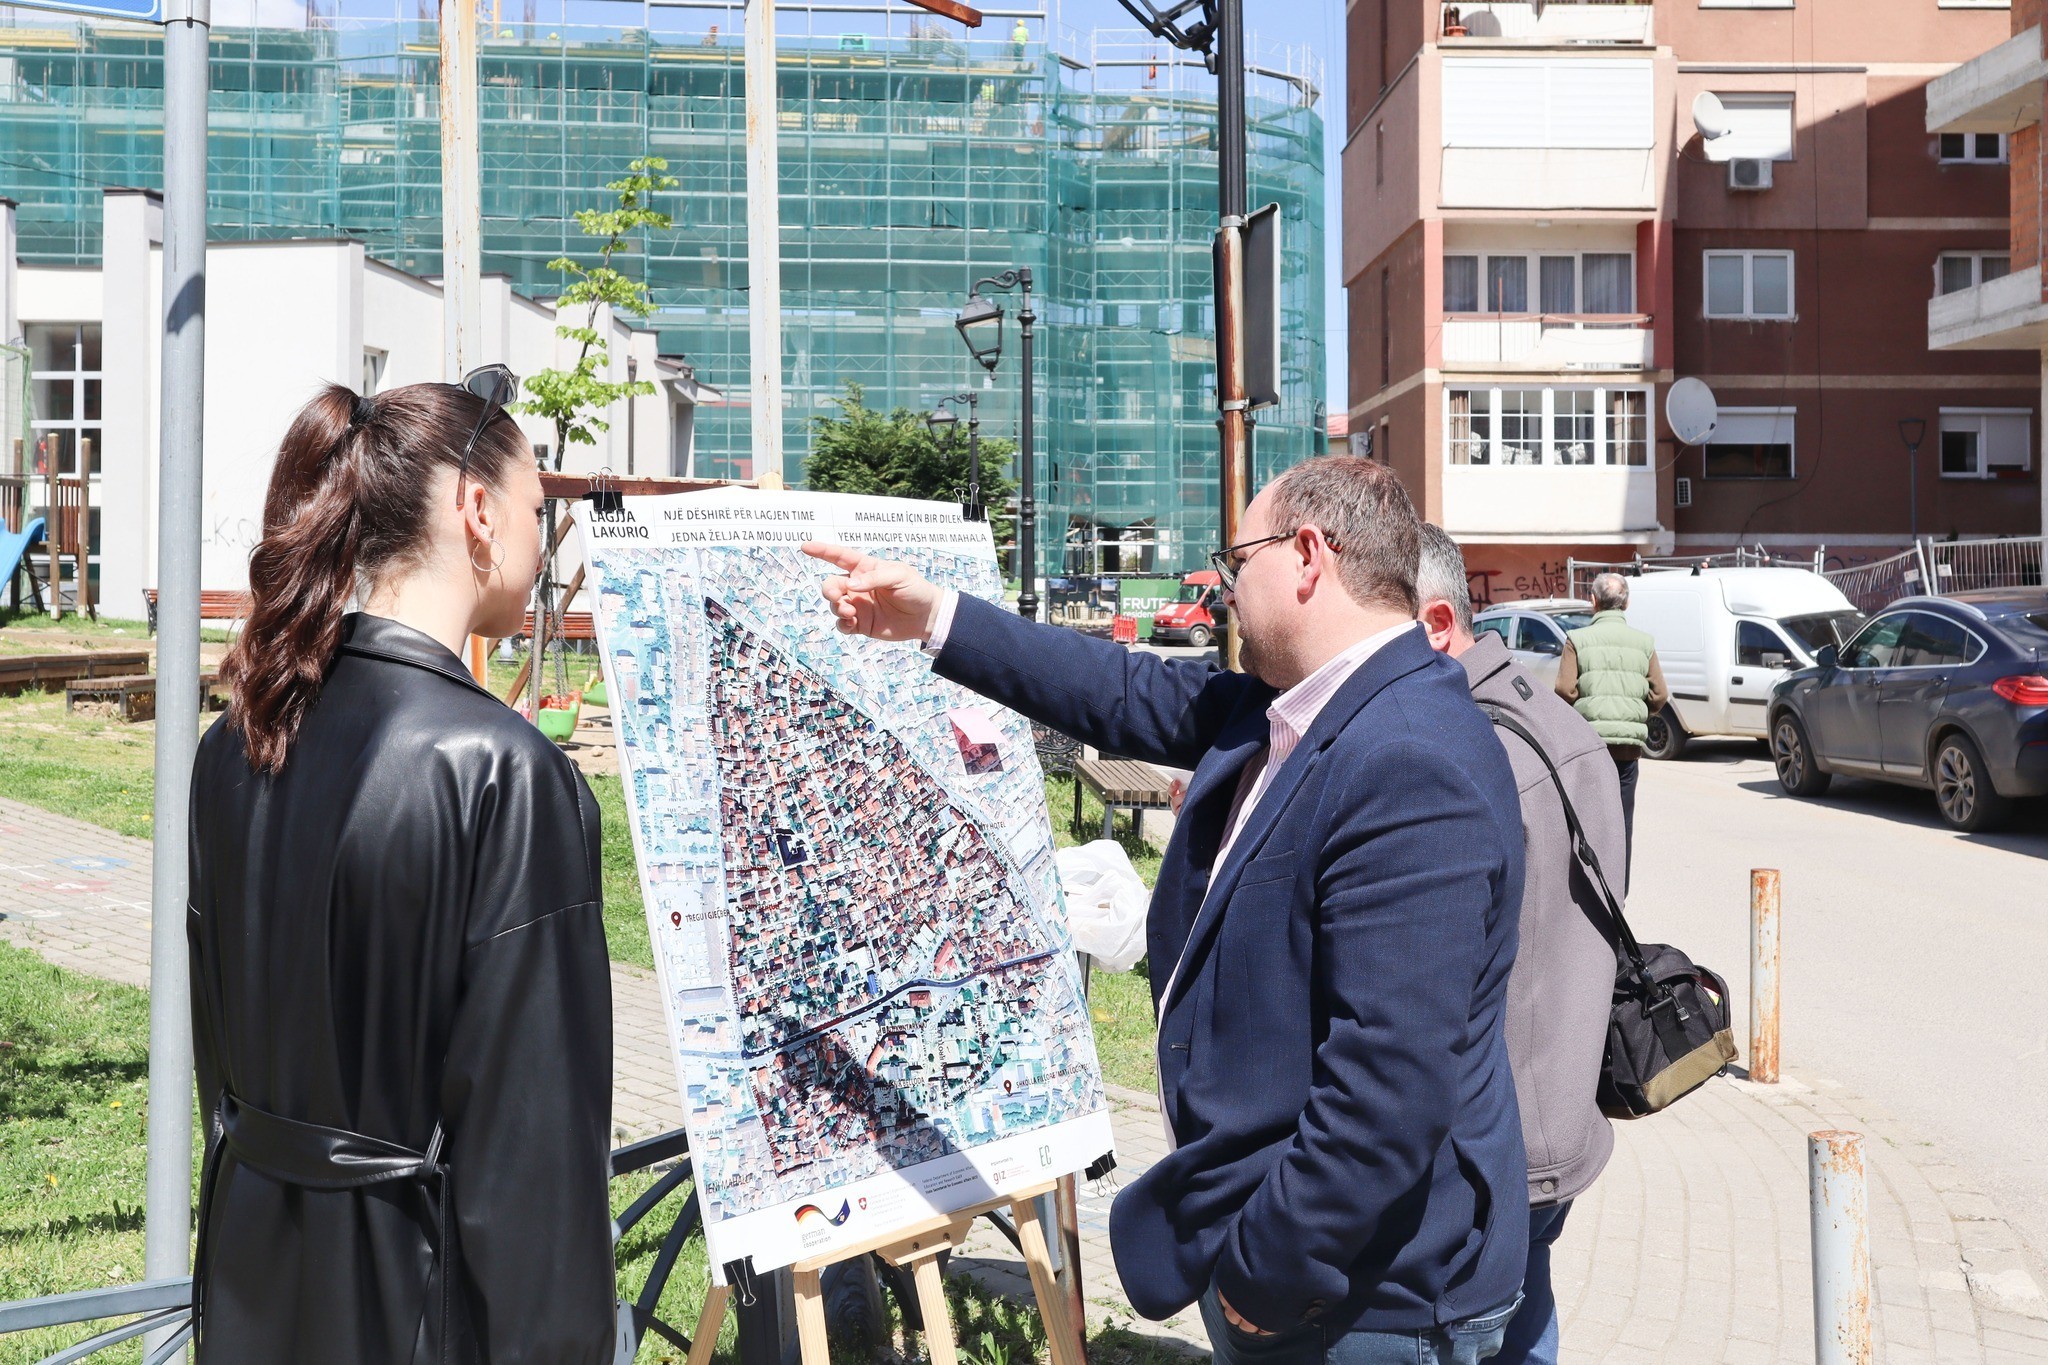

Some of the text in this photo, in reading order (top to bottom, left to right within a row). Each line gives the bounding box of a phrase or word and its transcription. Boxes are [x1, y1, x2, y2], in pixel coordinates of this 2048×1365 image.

[664, 507, 815, 520] NJË DËSHIRË PËR LAGJEN TIME
[855, 511, 904, 523] MAHALLEM
[924, 513, 938, 523] BIR
[939, 514, 963, 524] DILEK
[592, 526, 649, 540] LAKURIQ
[671, 529, 813, 542] JEDNA ŽELJA ZA MOJU ULICU
[838, 532, 987, 543] YEKH MANGIPE VASH MIRI MAHALA
[1004, 850, 1022, 876] DURHAM
[1039, 1145, 1052, 1167] EC
[993, 1170, 1006, 1185] giz
[802, 1228, 826, 1243] german
[803, 1235, 832, 1249] cooperation
